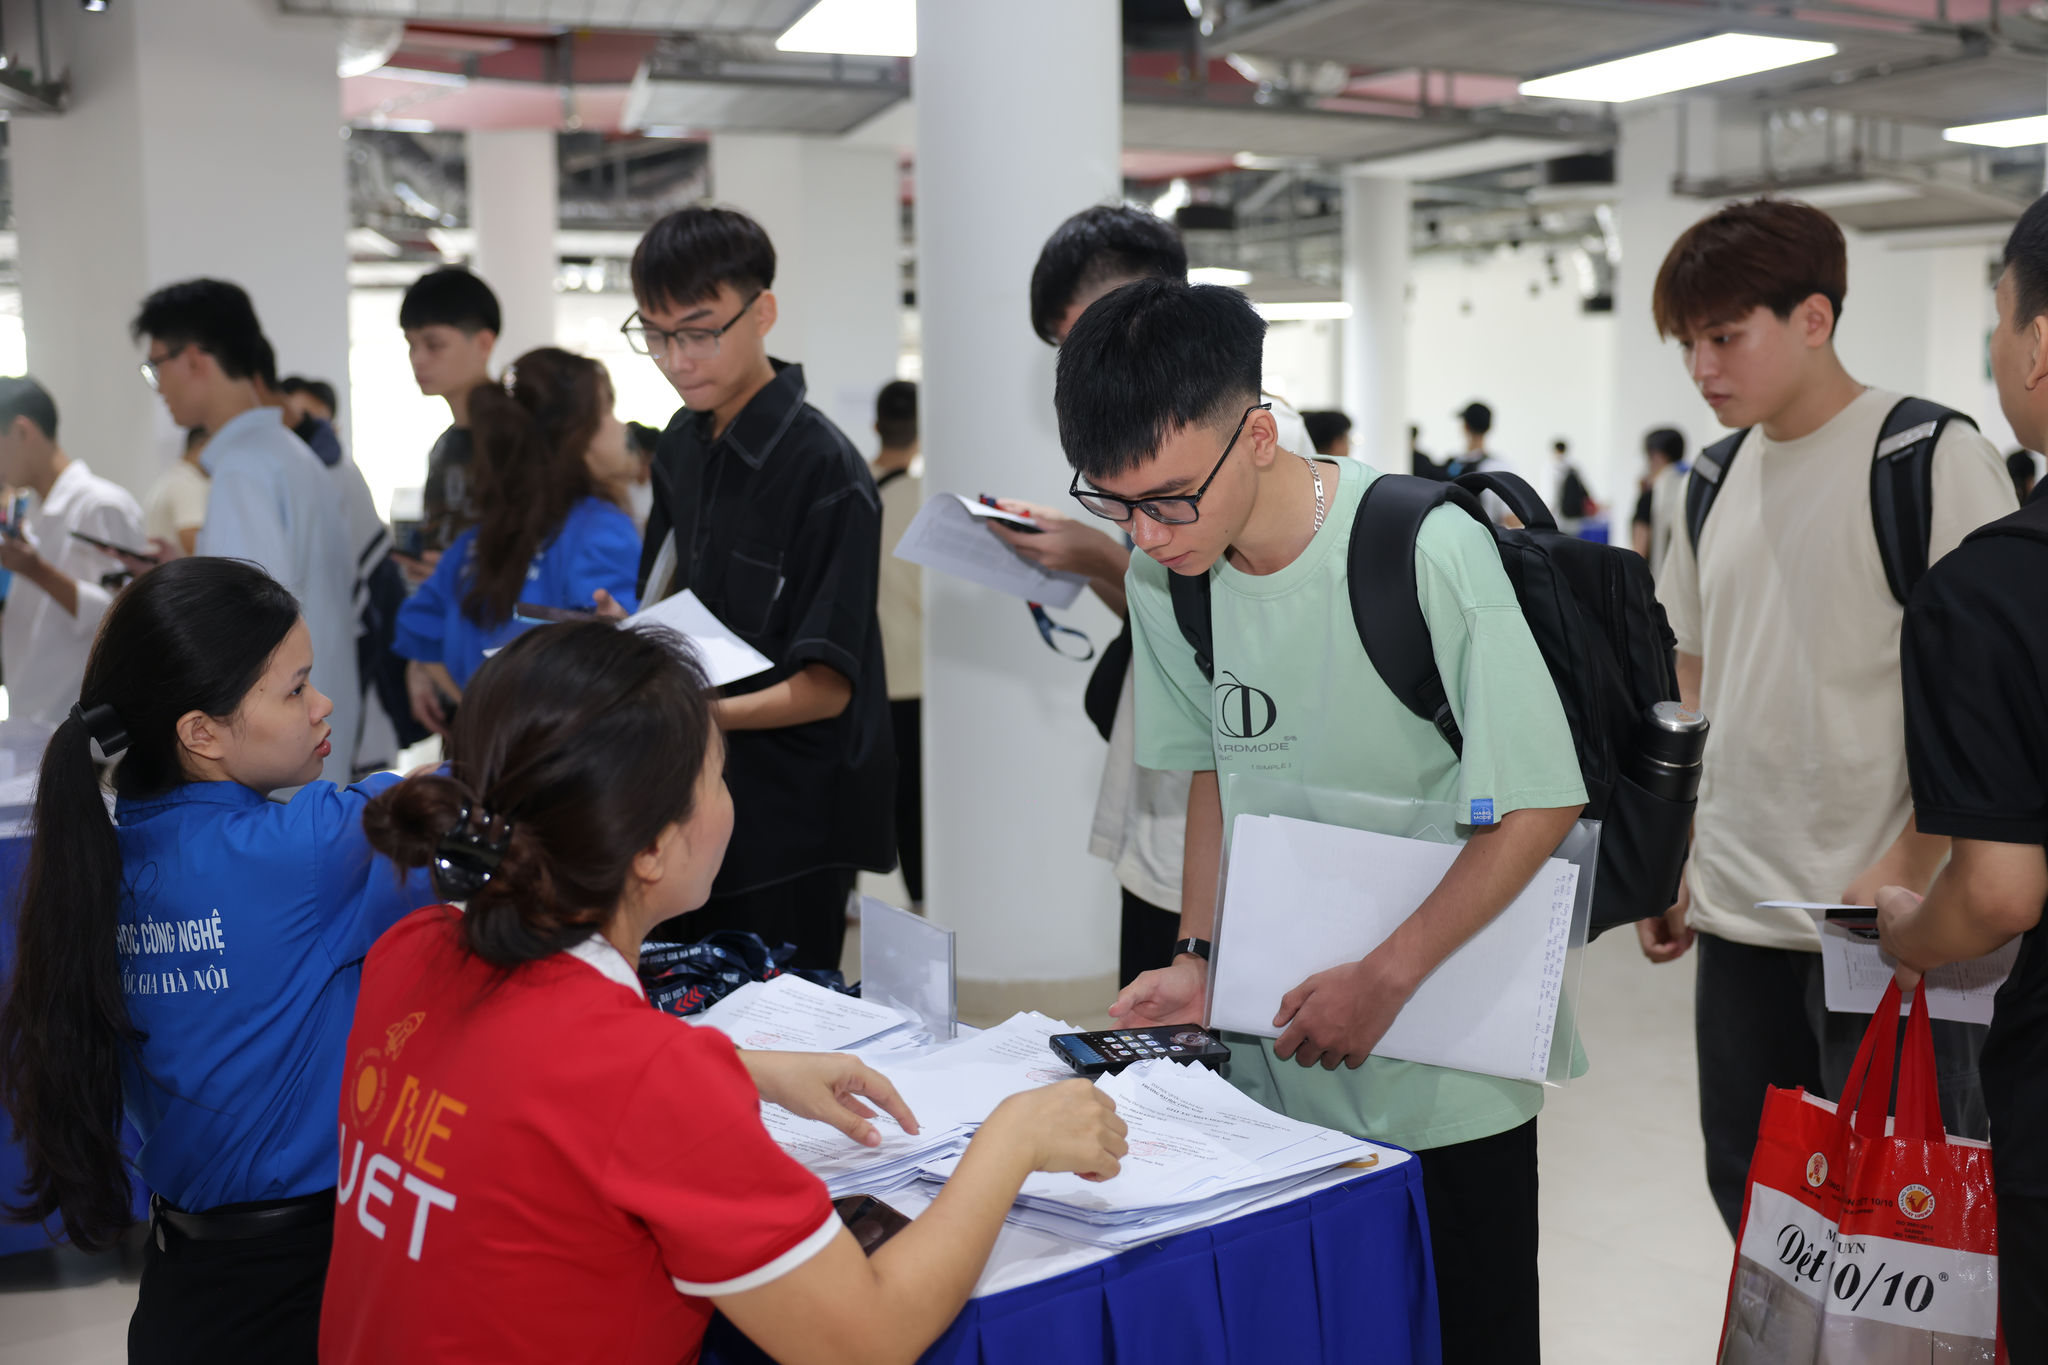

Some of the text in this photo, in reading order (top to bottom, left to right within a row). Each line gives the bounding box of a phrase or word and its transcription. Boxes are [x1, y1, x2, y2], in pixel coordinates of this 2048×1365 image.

[1218, 742, 1290, 753] ARDMODE
[141, 914, 175, 954] CÔNG
[177, 908, 225, 956] NGHỆ
[139, 973, 158, 995] GIA
[162, 967, 189, 994] HÀ
[193, 964, 229, 994] NỘI
[337, 1122, 457, 1262] UET
[1871, 1197, 1893, 1207] 10/10
[1777, 1224, 1828, 1283] Dệt
[1837, 1242, 1866, 1254] UYN
